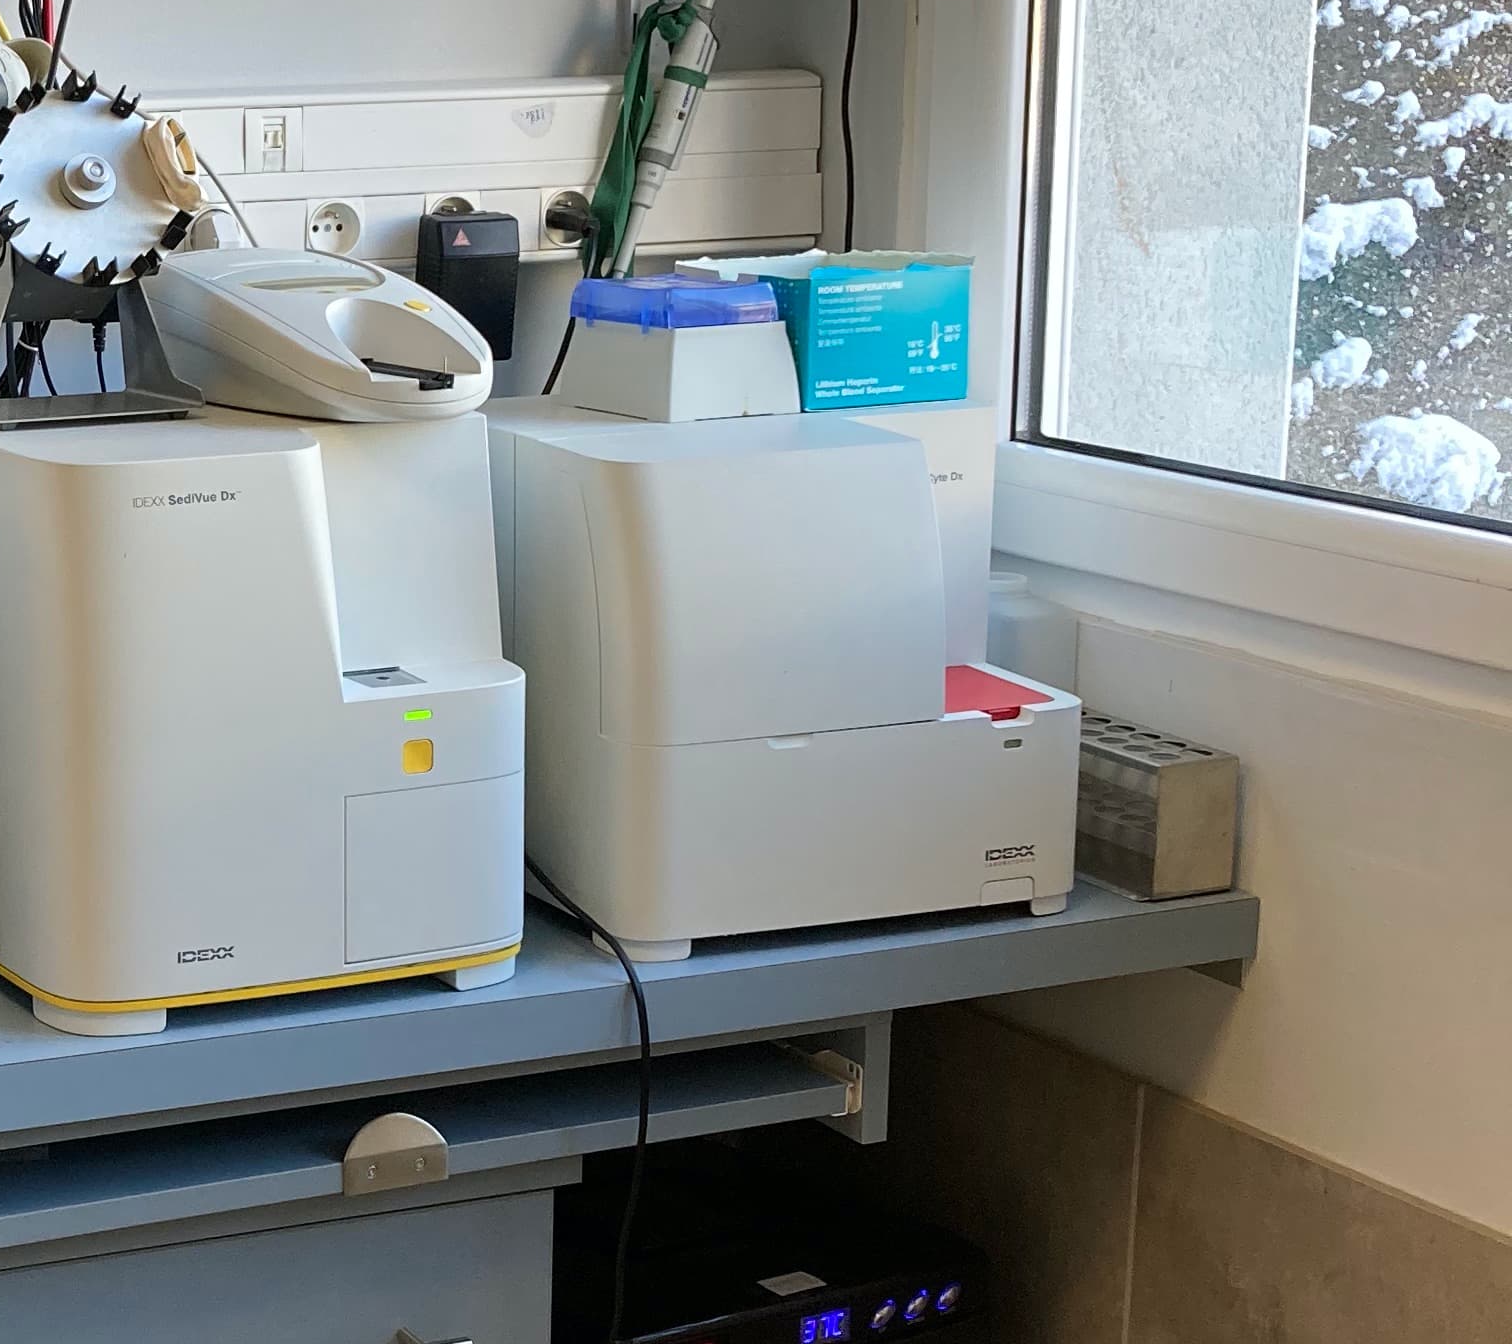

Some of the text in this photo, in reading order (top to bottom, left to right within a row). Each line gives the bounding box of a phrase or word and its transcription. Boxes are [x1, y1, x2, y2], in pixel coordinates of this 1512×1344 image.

[817, 280, 904, 295] ROOM TEMPERATURE
[815, 377, 880, 389] Lithium Heparin
[815, 385, 905, 399] Whole Blood Separator
[950, 471, 964, 481] Dx
[132, 496, 166, 509] IDEXX
[168, 492, 217, 506] SediVue
[985, 844, 1035, 862] IDEXX
[177, 946, 235, 964] IDEXX
